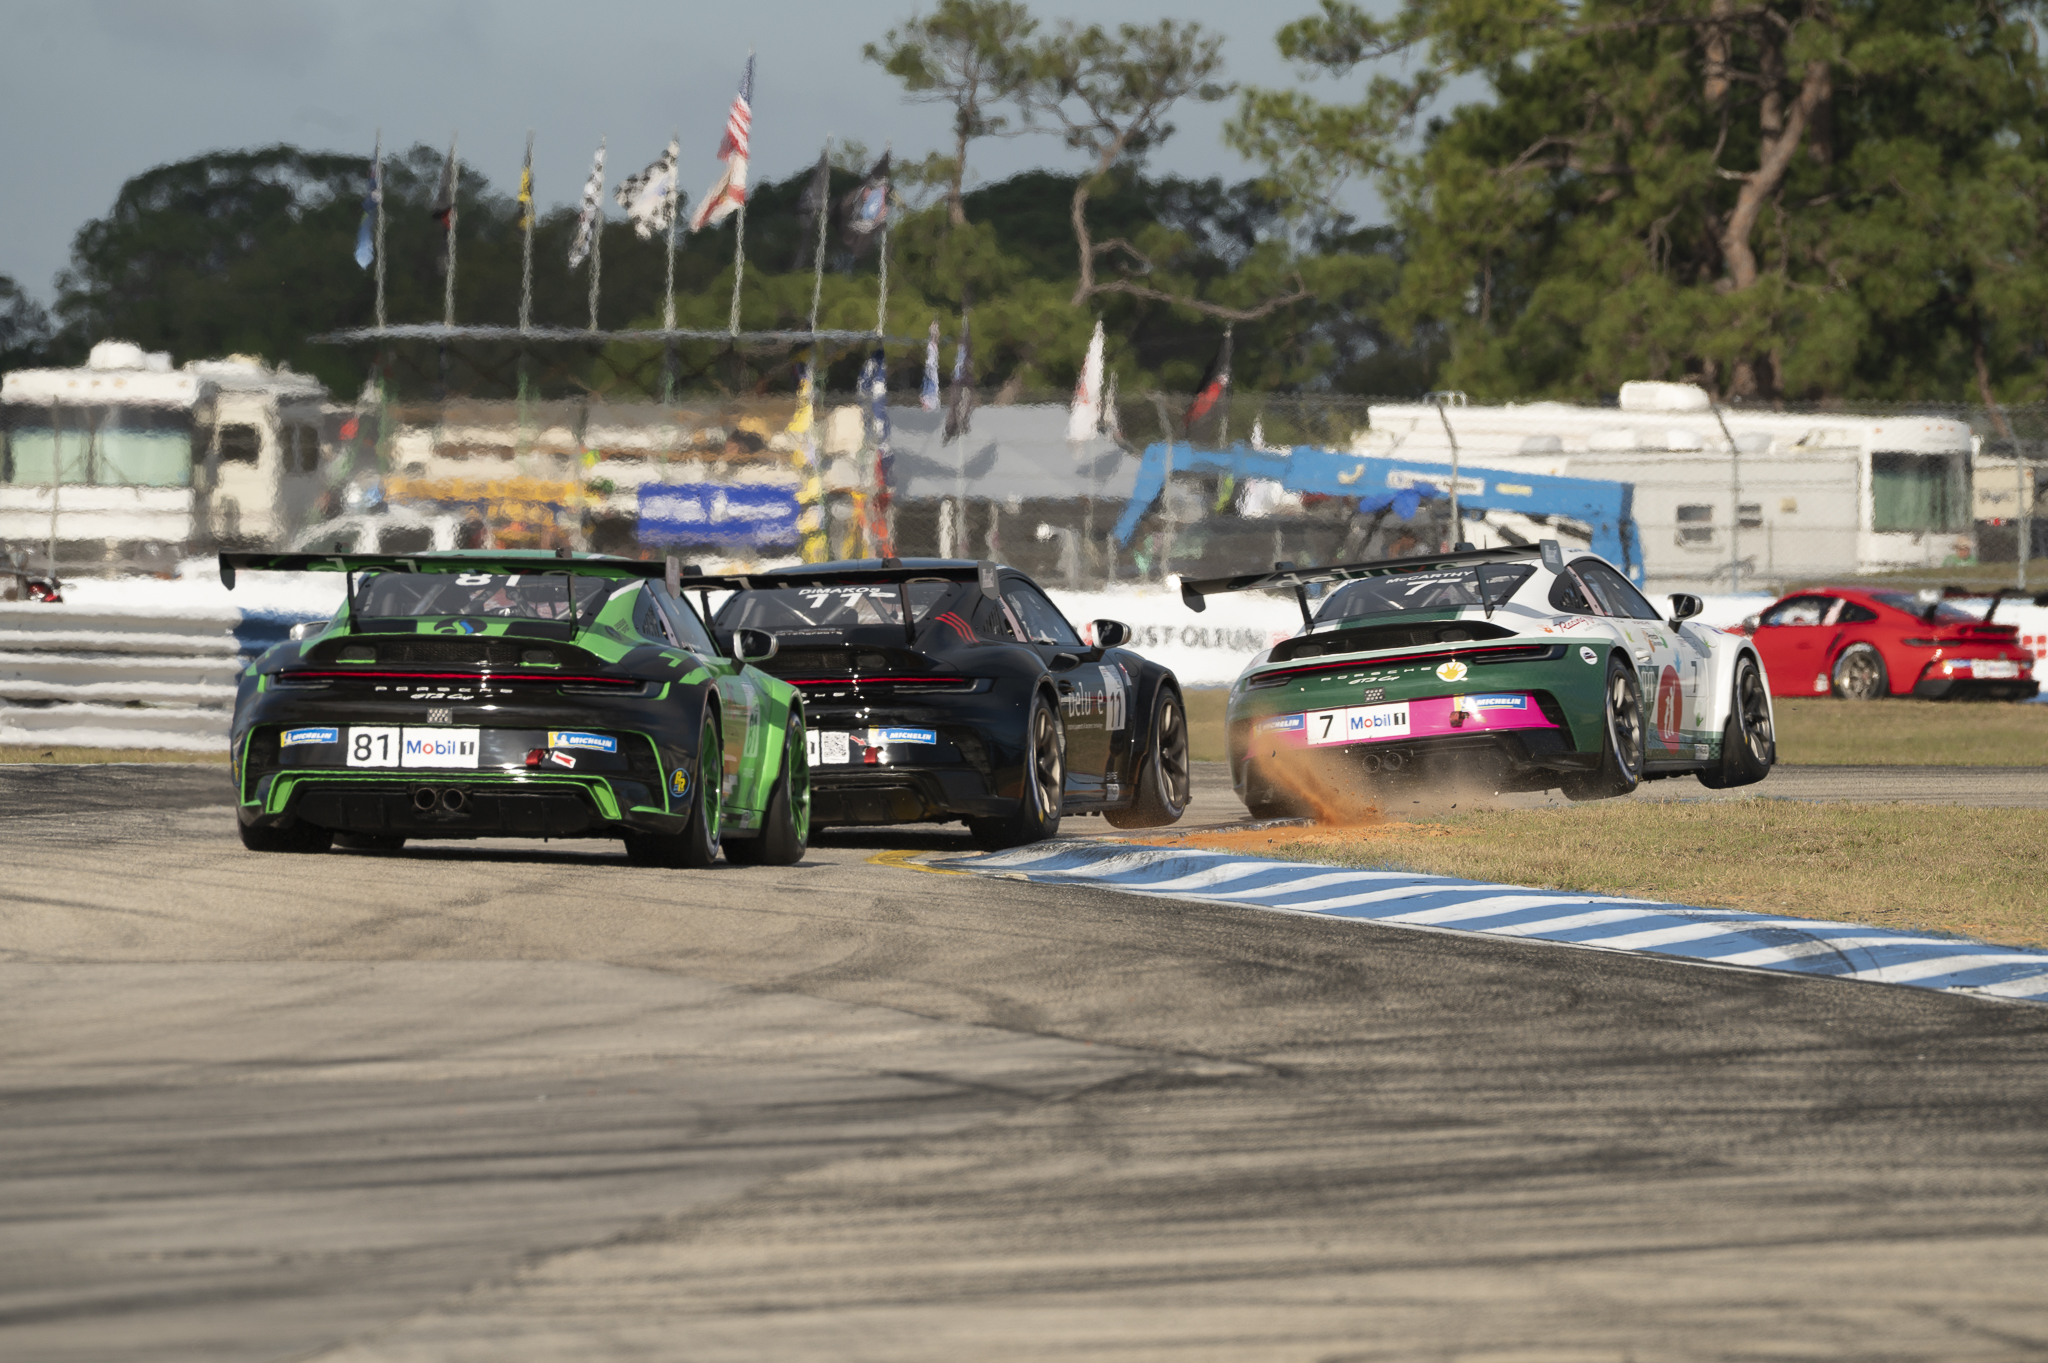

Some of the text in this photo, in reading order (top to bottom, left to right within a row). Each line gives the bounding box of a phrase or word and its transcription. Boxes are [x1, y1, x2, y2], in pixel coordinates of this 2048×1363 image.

[1386, 570, 1474, 585] McCARTHY
[798, 587, 881, 596] DIMAKOS
[1404, 579, 1438, 596] 7
[1476, 697, 1521, 706] MICHELIN
[1319, 714, 1334, 739] 7
[1350, 712, 1406, 731] Mobil 1
[292, 732, 332, 741] MICHELIN
[569, 736, 613, 747] MICHELIN
[890, 731, 932, 740] MICHELIN
[354, 733, 389, 761] 81
[406, 740, 474, 756] Mobil 1
